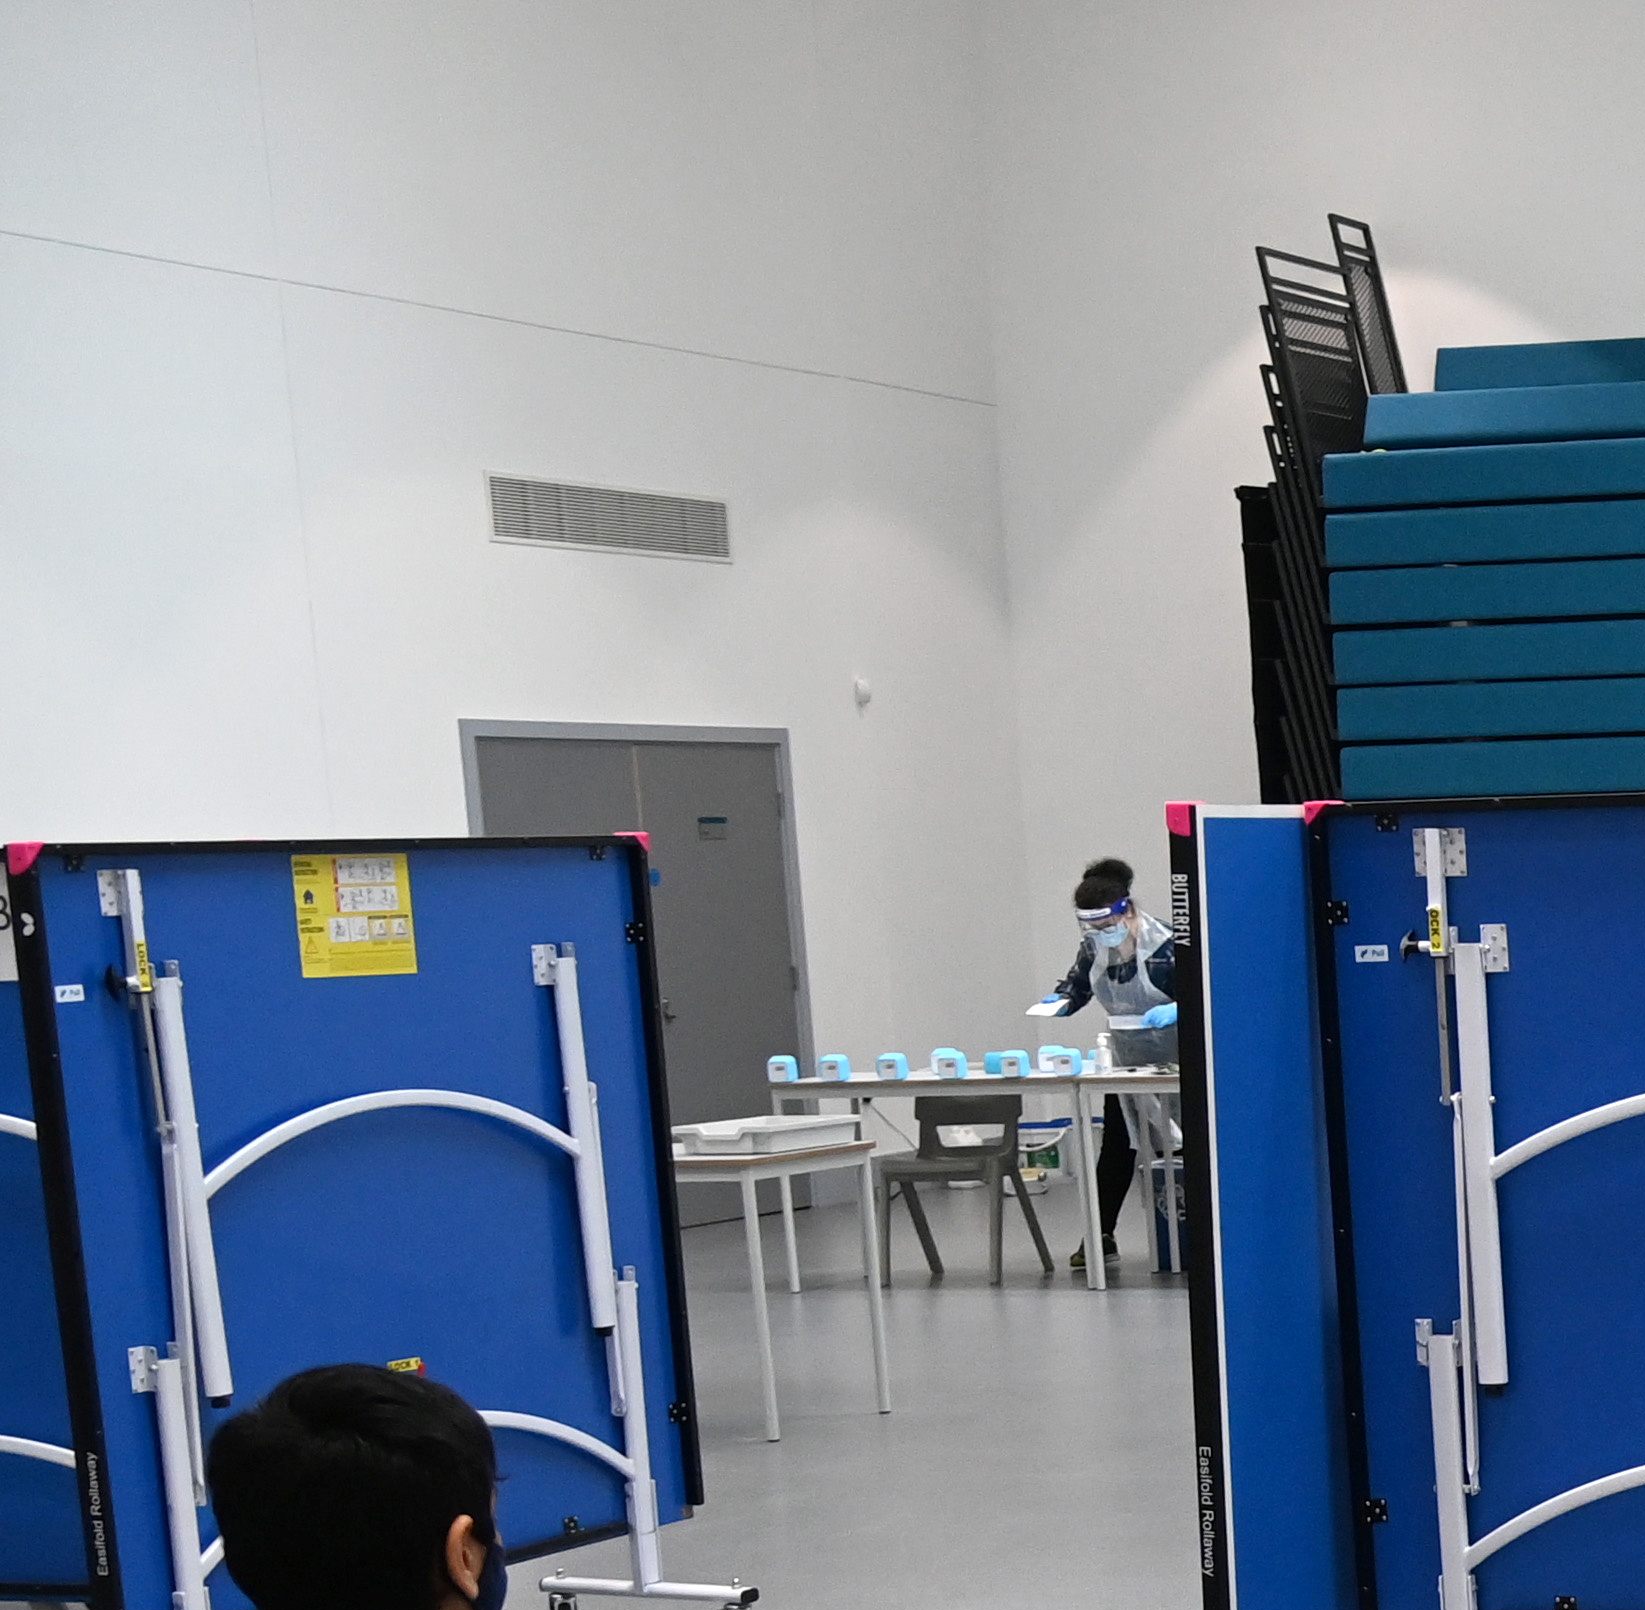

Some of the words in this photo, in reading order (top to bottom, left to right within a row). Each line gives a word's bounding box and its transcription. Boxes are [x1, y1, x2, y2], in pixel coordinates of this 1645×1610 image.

[1172, 874, 1191, 947] BUTTERFLY
[1430, 909, 1440, 937] OCK
[136, 943, 147, 975] LOCK
[86, 1452, 102, 1516] Rollaway
[1198, 1446, 1213, 1505] Easifold
[92, 1520, 109, 1576] Easifold
[1202, 1510, 1215, 1577] Rollaway
